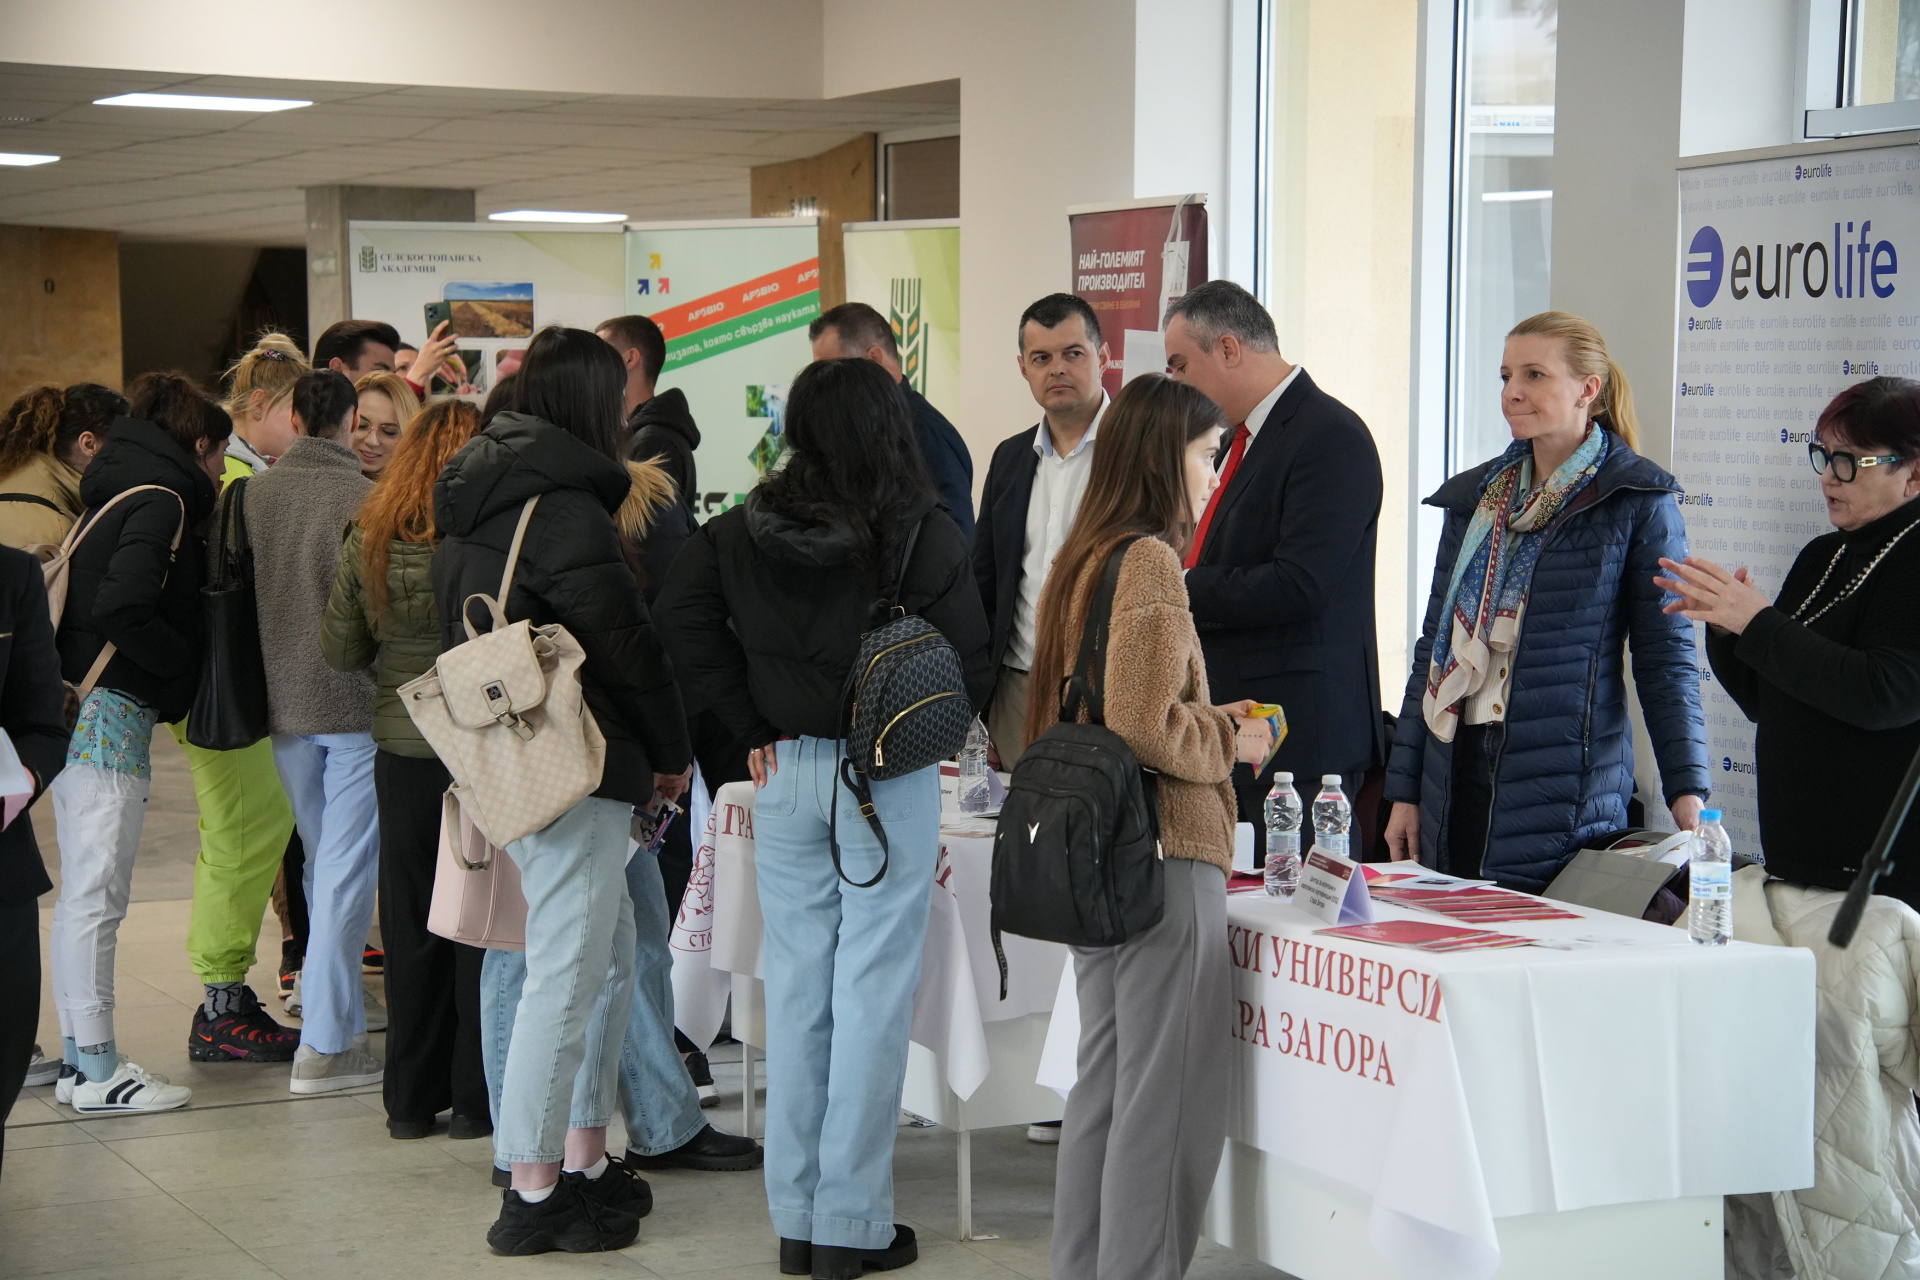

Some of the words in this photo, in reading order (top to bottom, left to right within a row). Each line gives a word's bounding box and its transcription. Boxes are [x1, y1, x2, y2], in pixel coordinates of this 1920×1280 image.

[1802, 163, 1832, 179] eurolife
[380, 253, 482, 263] СЕЛСКОСТОПАНСКА
[1079, 249, 1146, 269] НАЙ-ГОЛЕМИЯТ
[1730, 220, 1898, 301] eurolife
[381, 265, 436, 273] АКАДЕМИЯ
[1077, 272, 1146, 293] ПРОИЗВОДИТЕЛ
[702, 332, 733, 349] която
[734, 317, 774, 339] свързва
[775, 304, 816, 325] науката
[1695, 316, 1722, 331] eurolife
[1850, 360, 1879, 375] eurolife
[1687, 382, 1715, 396] eurolife
[1684, 492, 1714, 507] eurolife
[1278, 1011, 1396, 1087] ЗАГОРА
